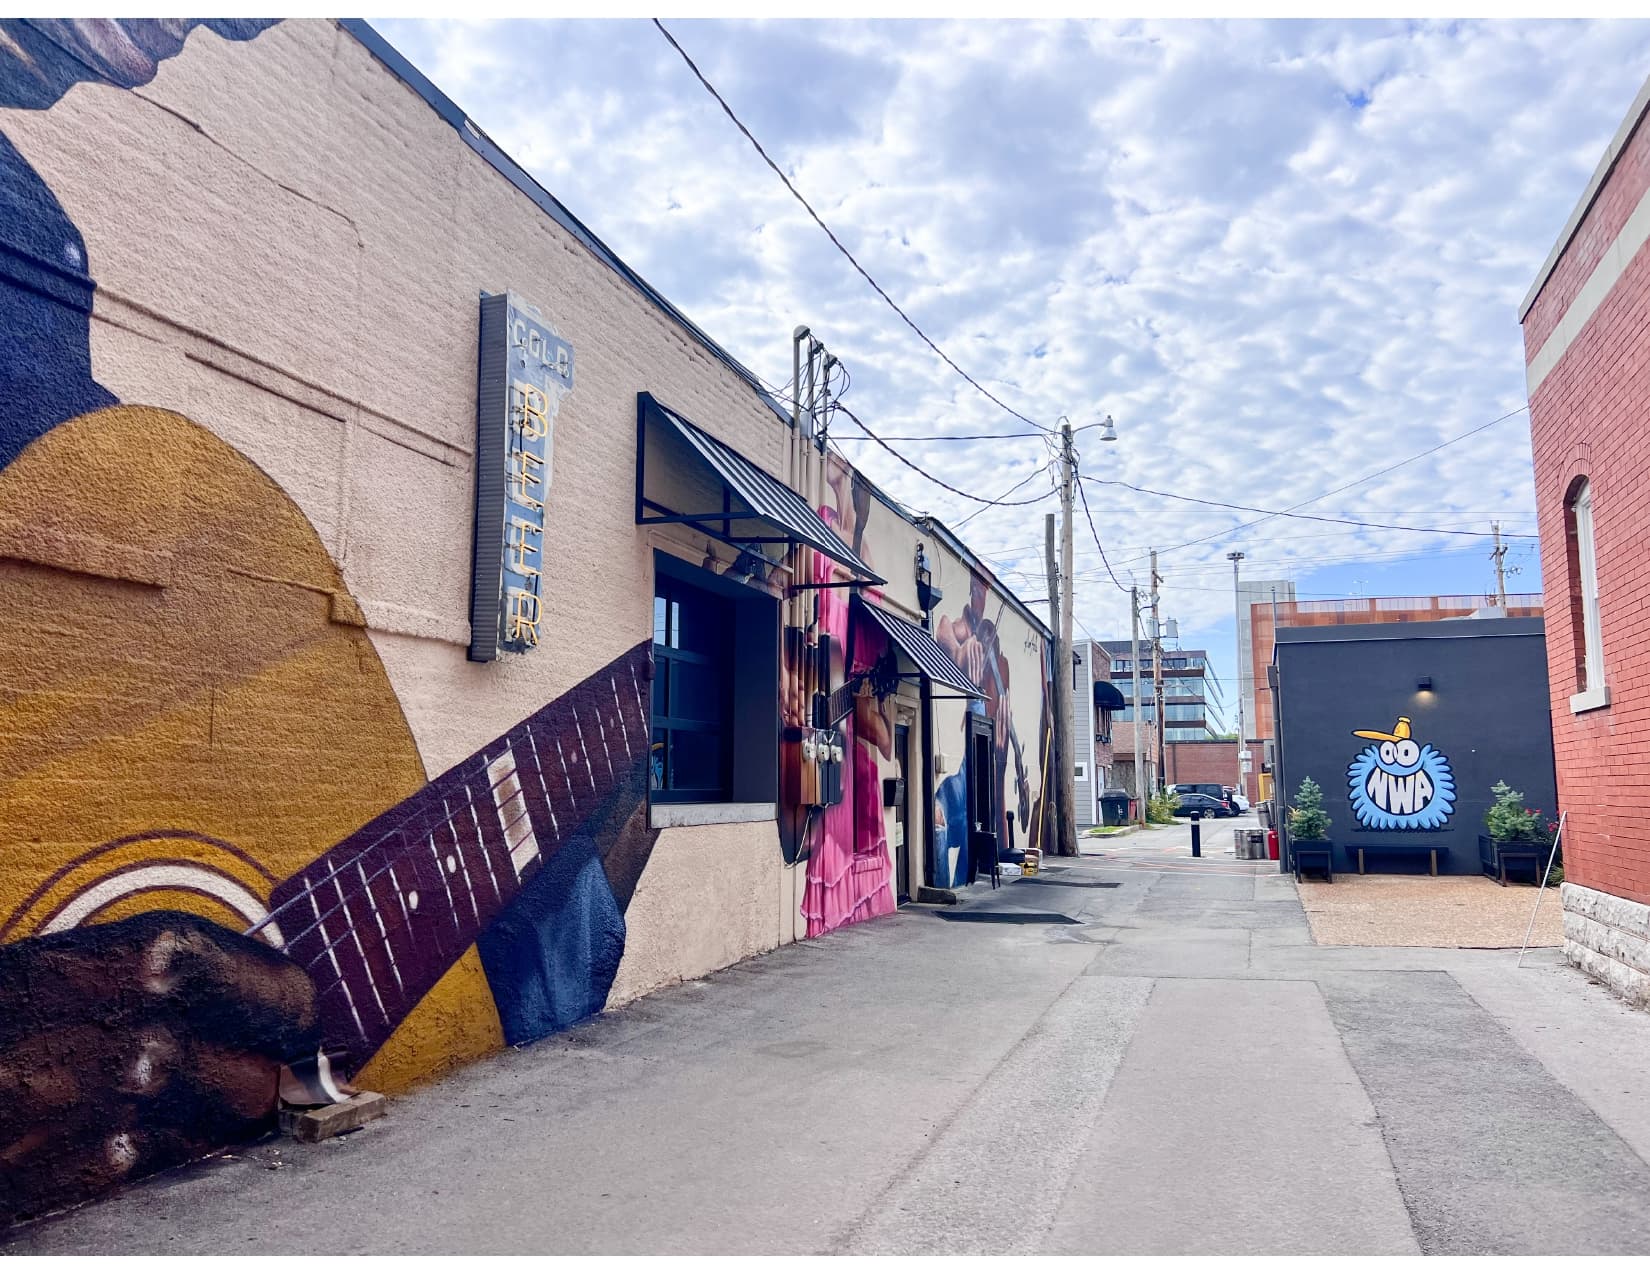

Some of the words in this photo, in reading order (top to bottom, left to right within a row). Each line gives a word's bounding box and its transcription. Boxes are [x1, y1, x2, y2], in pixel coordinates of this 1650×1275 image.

[513, 319, 570, 377] COLD
[506, 380, 548, 646] BEER
[1367, 766, 1433, 814] NWA
